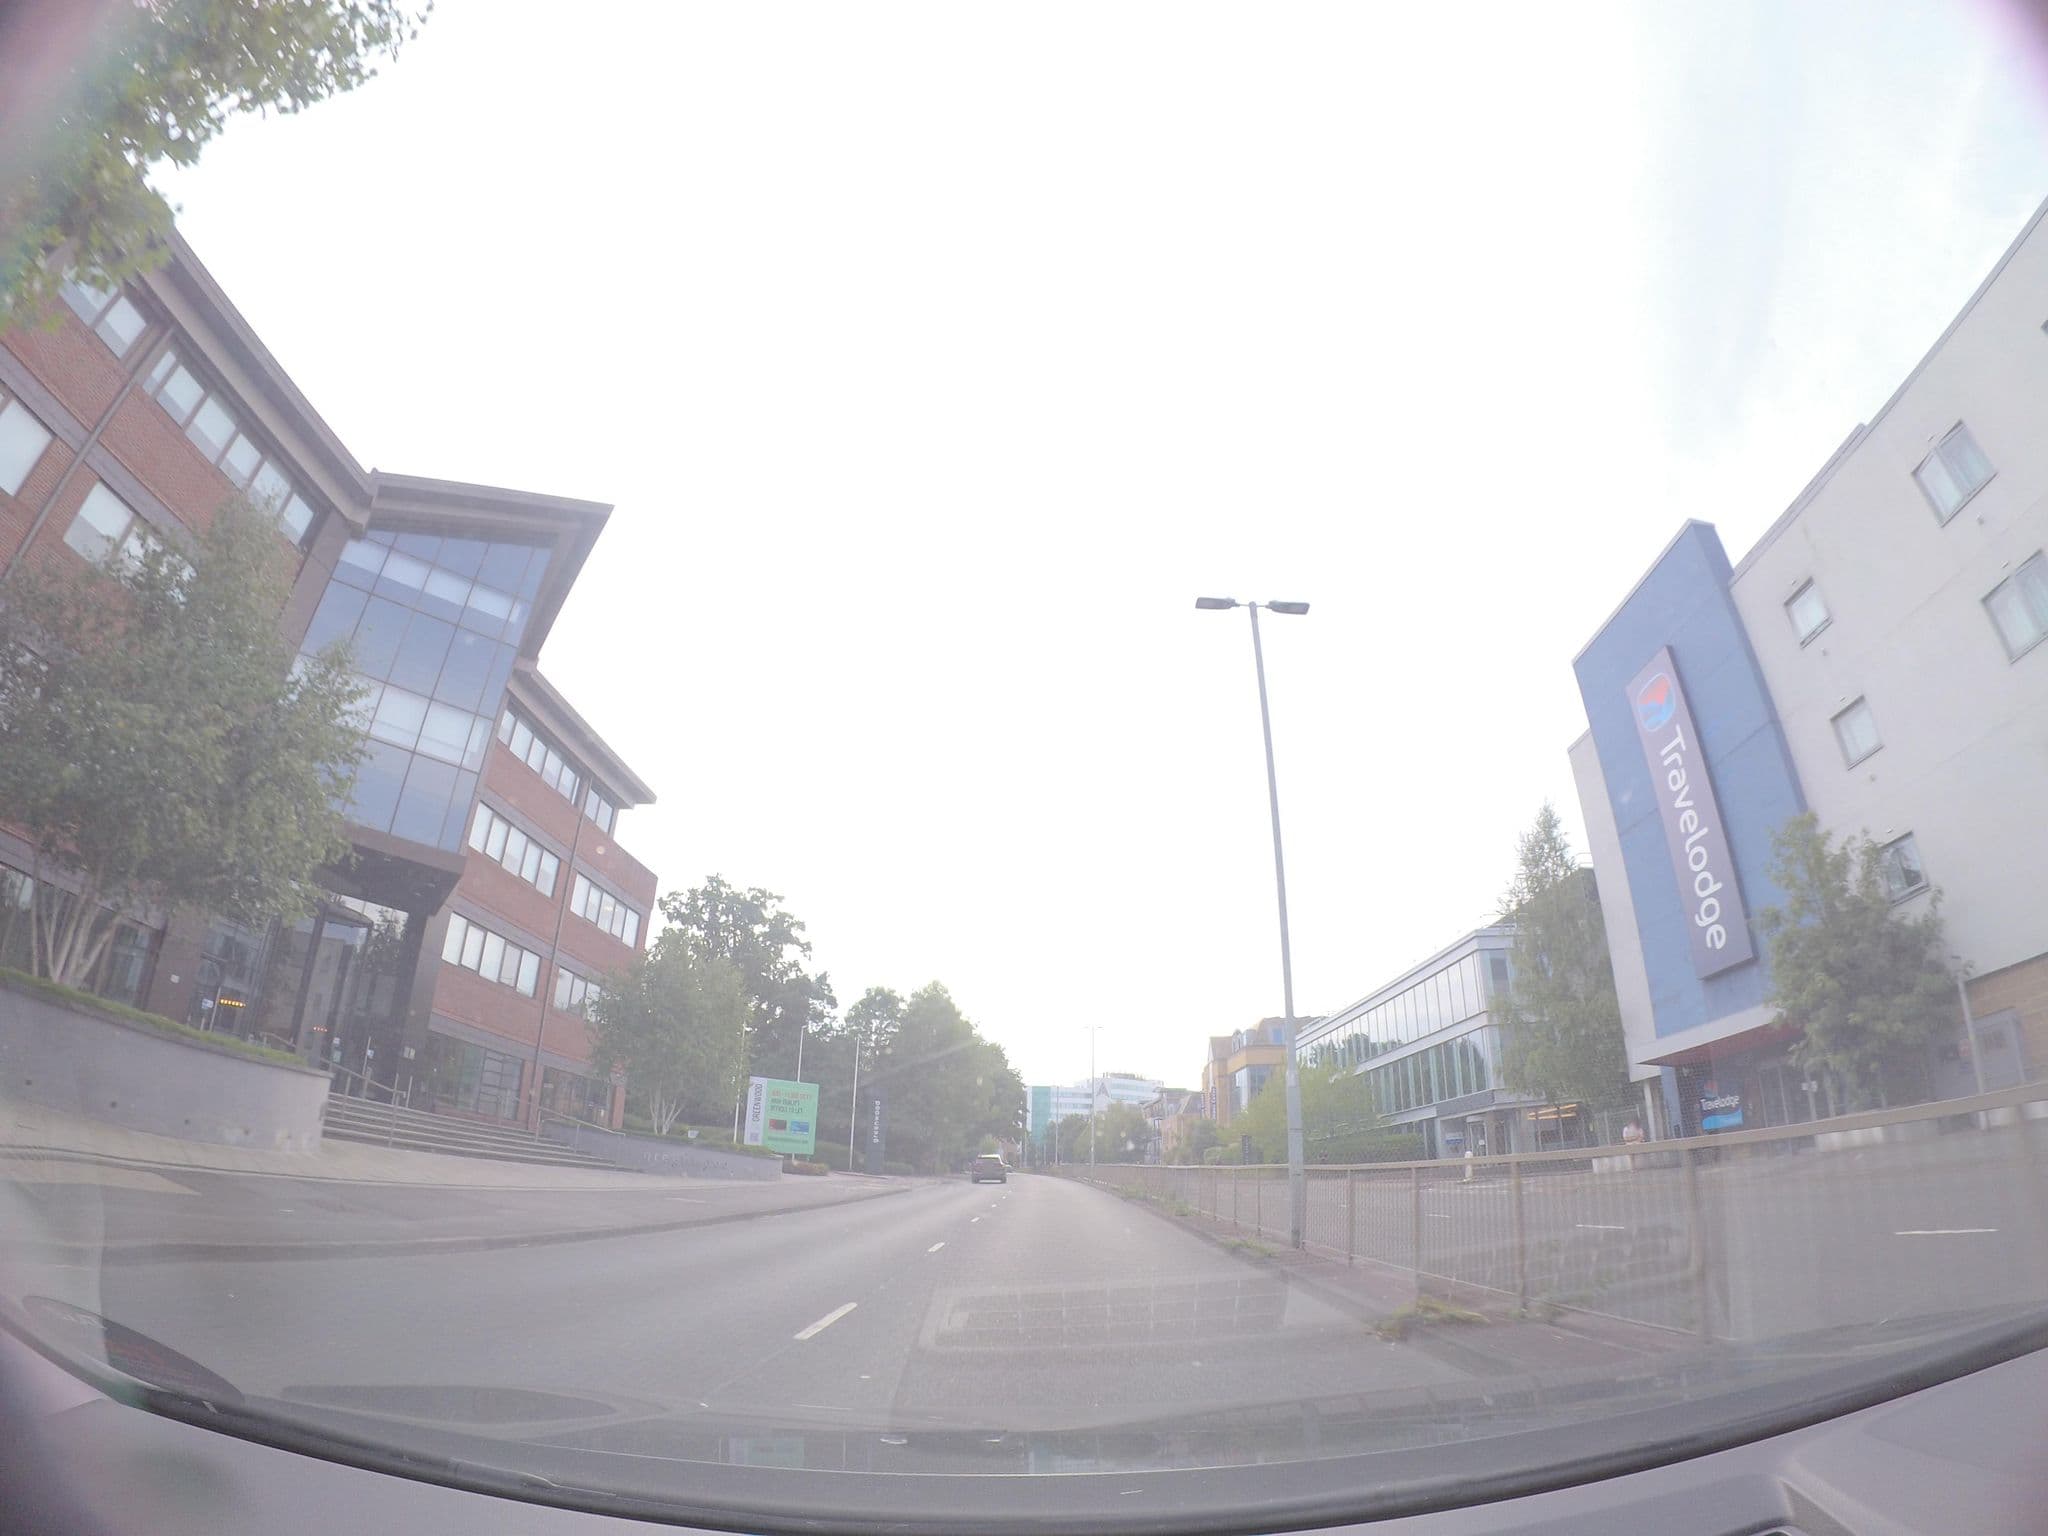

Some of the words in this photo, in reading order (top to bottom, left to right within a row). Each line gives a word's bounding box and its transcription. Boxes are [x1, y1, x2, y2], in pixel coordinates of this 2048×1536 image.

[1660, 723, 1727, 950] Travelodge
[752, 1083, 762, 1122] GREENWOOD
[1700, 1095, 1740, 1111] Travelodge
